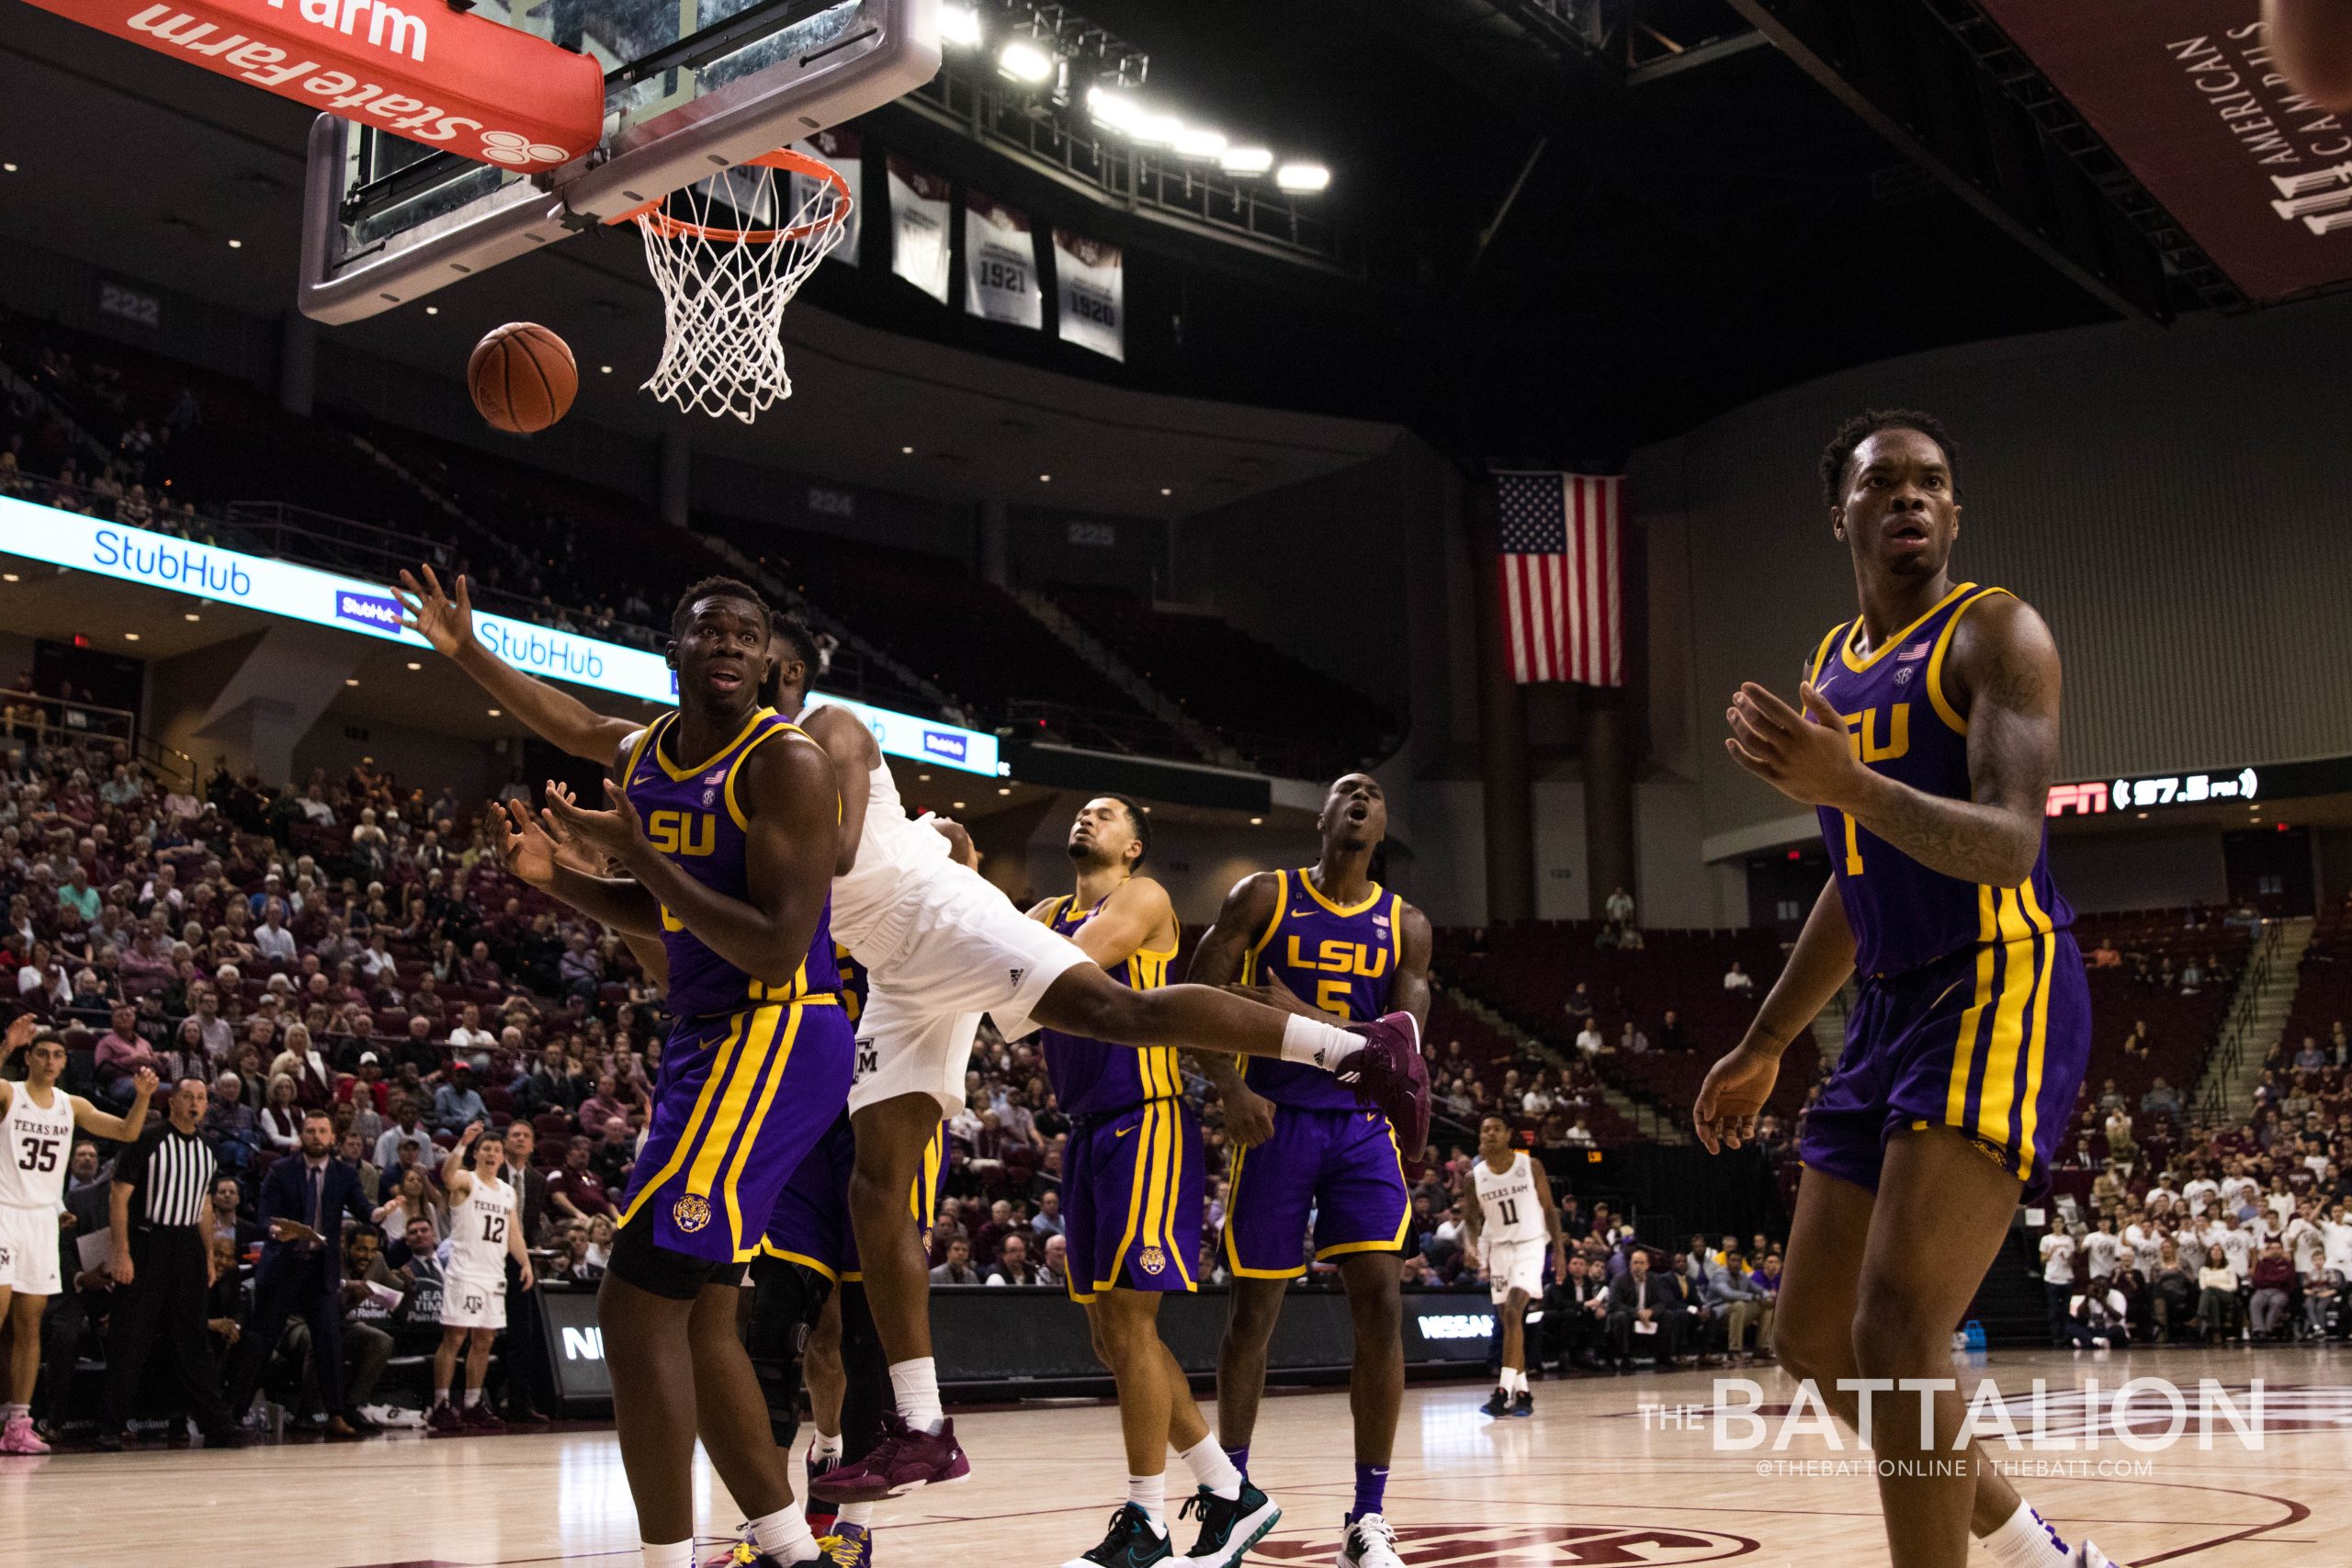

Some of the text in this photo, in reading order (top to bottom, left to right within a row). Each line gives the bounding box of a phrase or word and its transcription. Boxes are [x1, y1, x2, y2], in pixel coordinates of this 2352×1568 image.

[268, 0, 428, 62] arm
[2165, 35, 2301, 164] AMERICAN
[980, 261, 1026, 293] 1921
[1070, 291, 1114, 327] 1920
[94, 530, 251, 596] StubHub
[481, 622, 603, 678] StubHub
[649, 809, 716, 857] SU
[1288, 935, 1388, 978] LSU
[1317, 979, 1351, 1021] 5
[14, 1119, 51, 1135] TEXAS
[19, 1137, 60, 1172] 35
[1481, 1187, 1509, 1201] TEXAS
[1498, 1198, 1519, 1225] 11
[482, 1214, 505, 1243] 12
